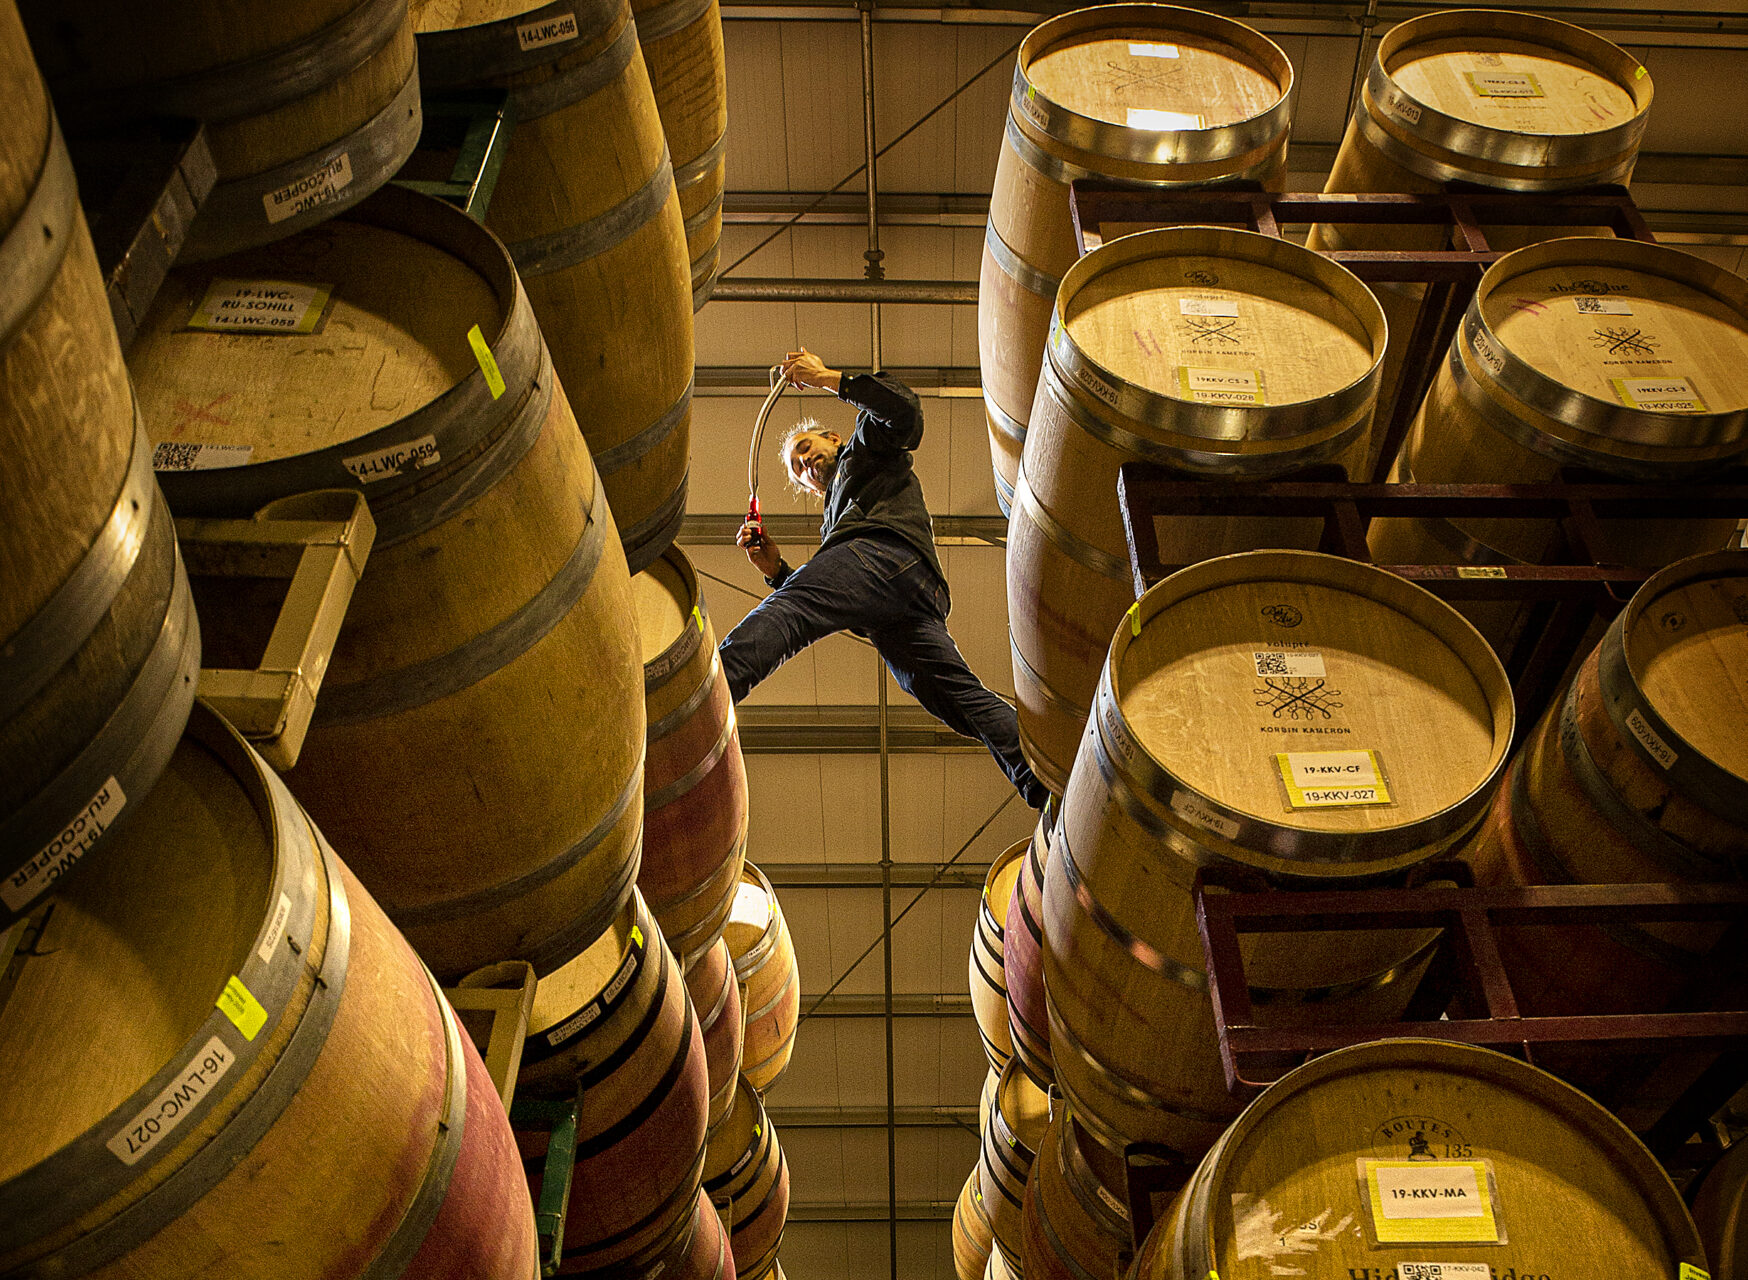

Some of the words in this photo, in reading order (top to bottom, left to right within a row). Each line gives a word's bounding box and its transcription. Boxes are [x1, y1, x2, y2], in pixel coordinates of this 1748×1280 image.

[221, 300, 295, 312] RU-SOHILL
[1260, 726, 1298, 734] KORBIN
[1304, 765, 1361, 774] 19-KKV-CF
[1305, 789, 1375, 801] 19-KKV-027
[11, 788, 111, 888] RU-COOPER
[125, 1048, 226, 1155] 16-LWC-027
[1381, 1119, 1453, 1139] BOUTES
[1392, 1188, 1467, 1199] 19-KKV-MA
